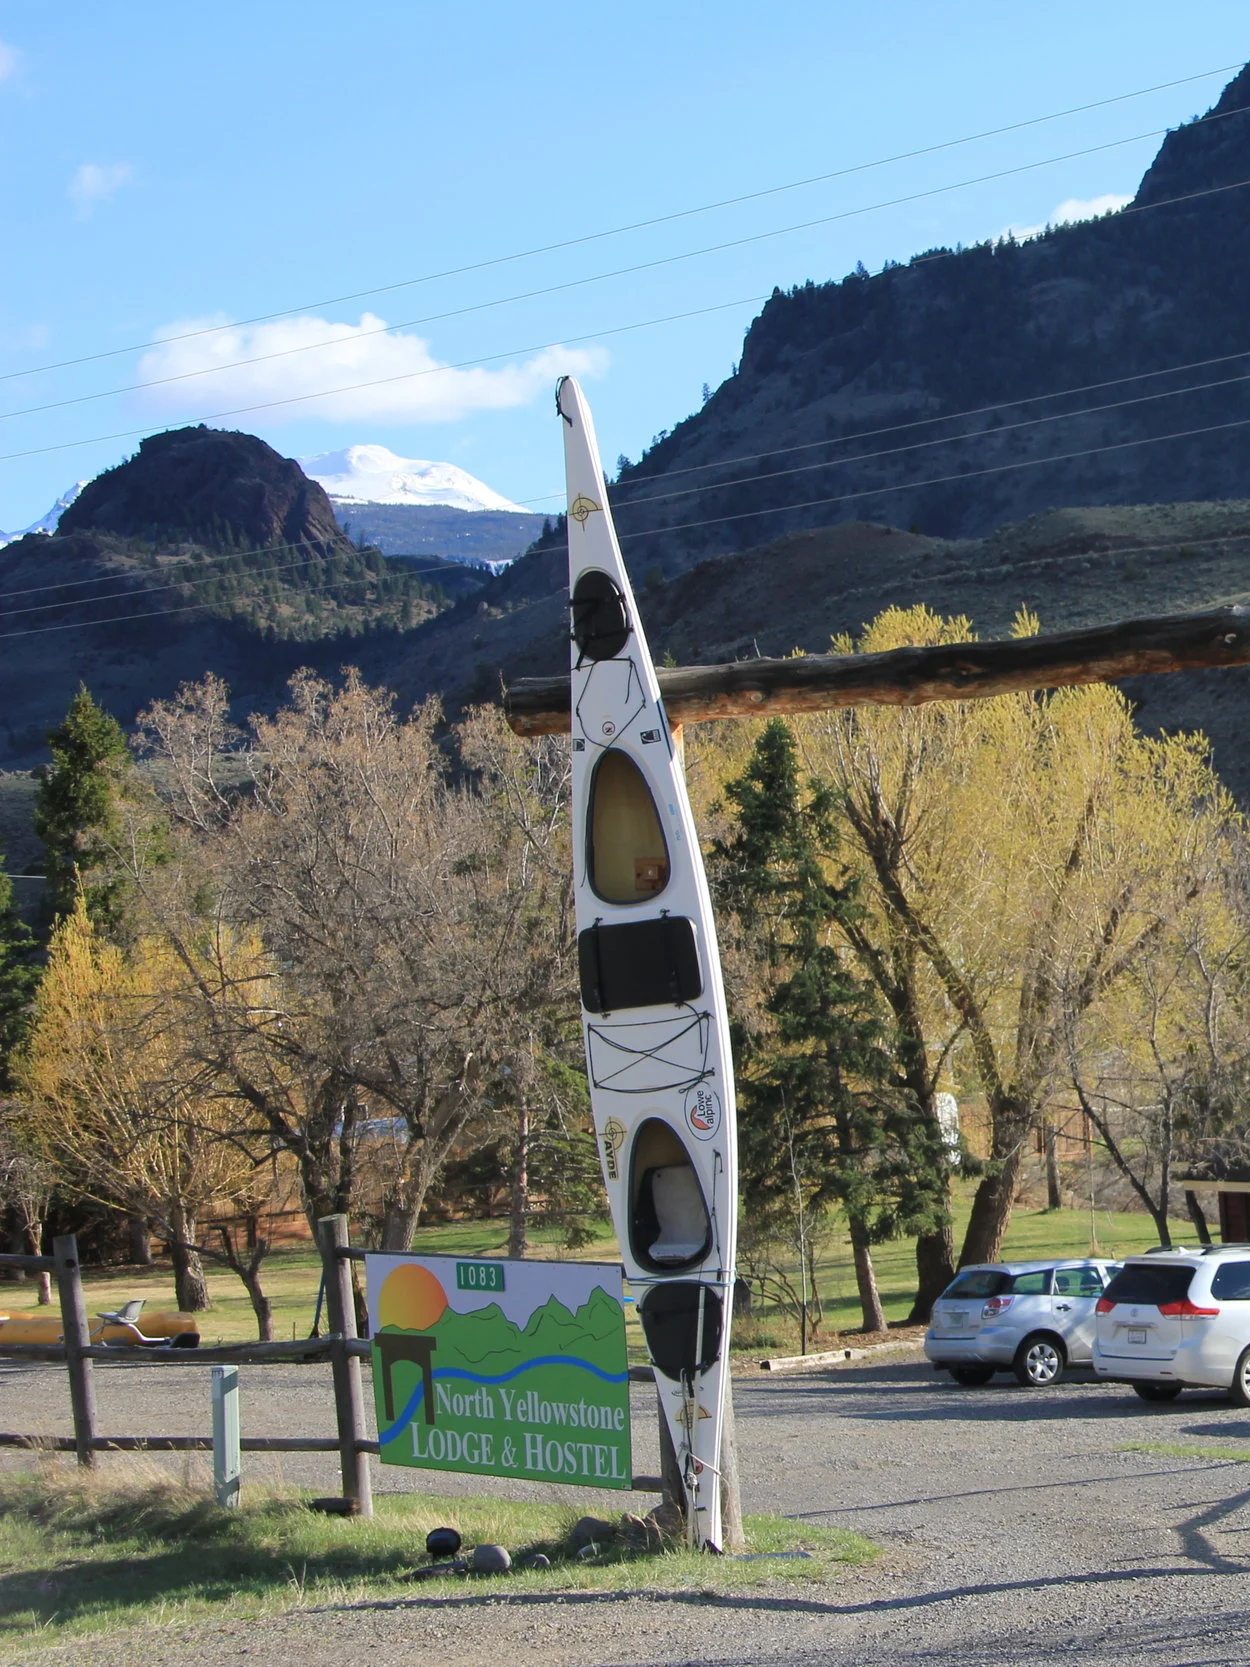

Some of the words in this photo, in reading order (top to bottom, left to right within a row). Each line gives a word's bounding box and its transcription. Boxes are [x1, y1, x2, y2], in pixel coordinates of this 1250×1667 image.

[697, 1090, 706, 1117] Lowe
[460, 1266, 496, 1287] 1083
[434, 1383, 495, 1419] North
[498, 1388, 625, 1431] Yellowstone
[409, 1421, 495, 1466] LODGE
[501, 1436, 519, 1468] &
[523, 1432, 626, 1480] HOSTEL
